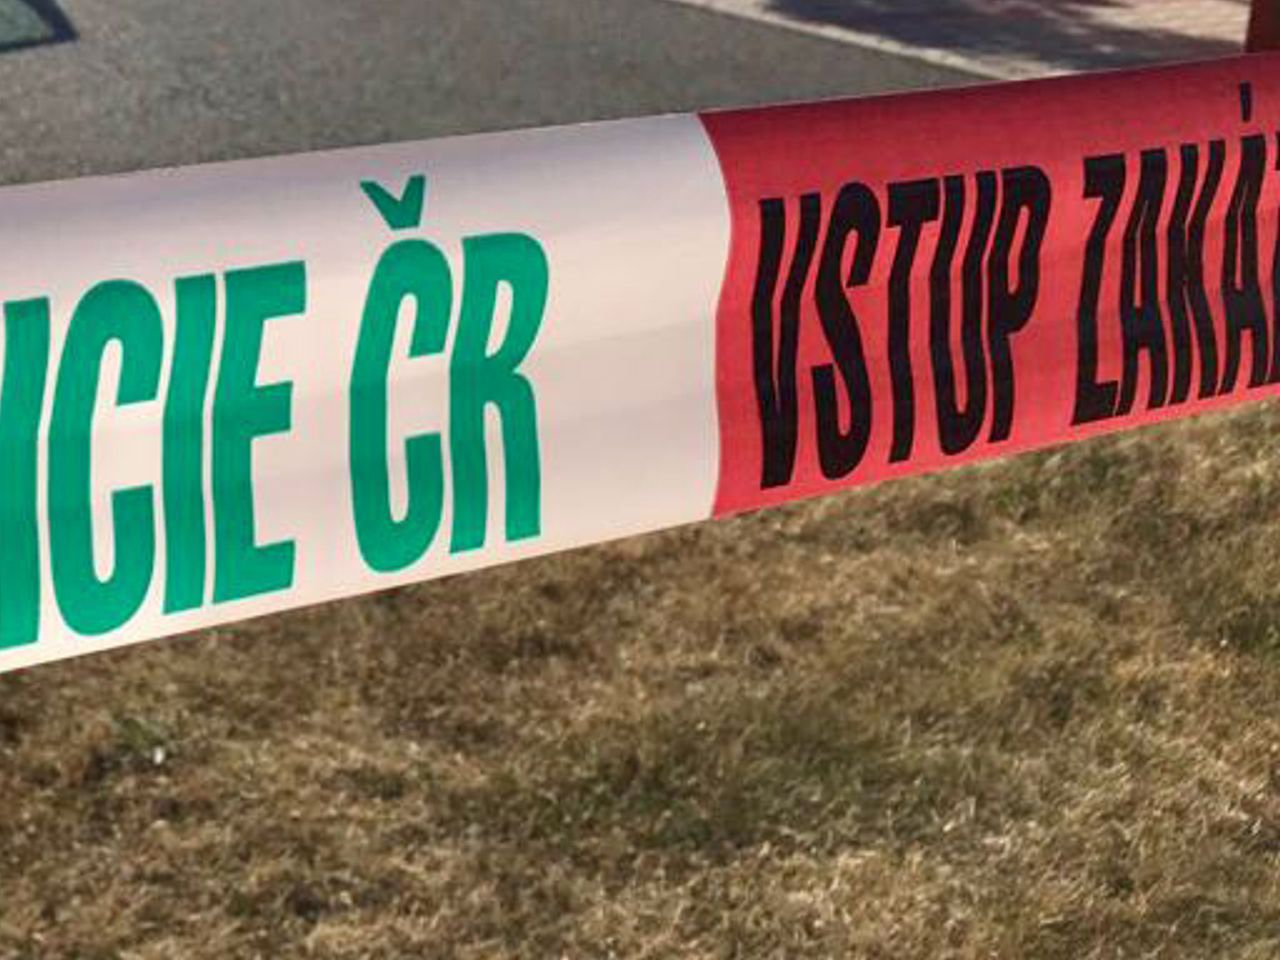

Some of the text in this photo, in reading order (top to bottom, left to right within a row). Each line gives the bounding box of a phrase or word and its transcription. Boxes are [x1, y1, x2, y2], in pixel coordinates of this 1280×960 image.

[350, 175, 550, 573] ČR
[751, 165, 1052, 489] VSTUP
[1071, 81, 1280, 426] ZAKÁ
